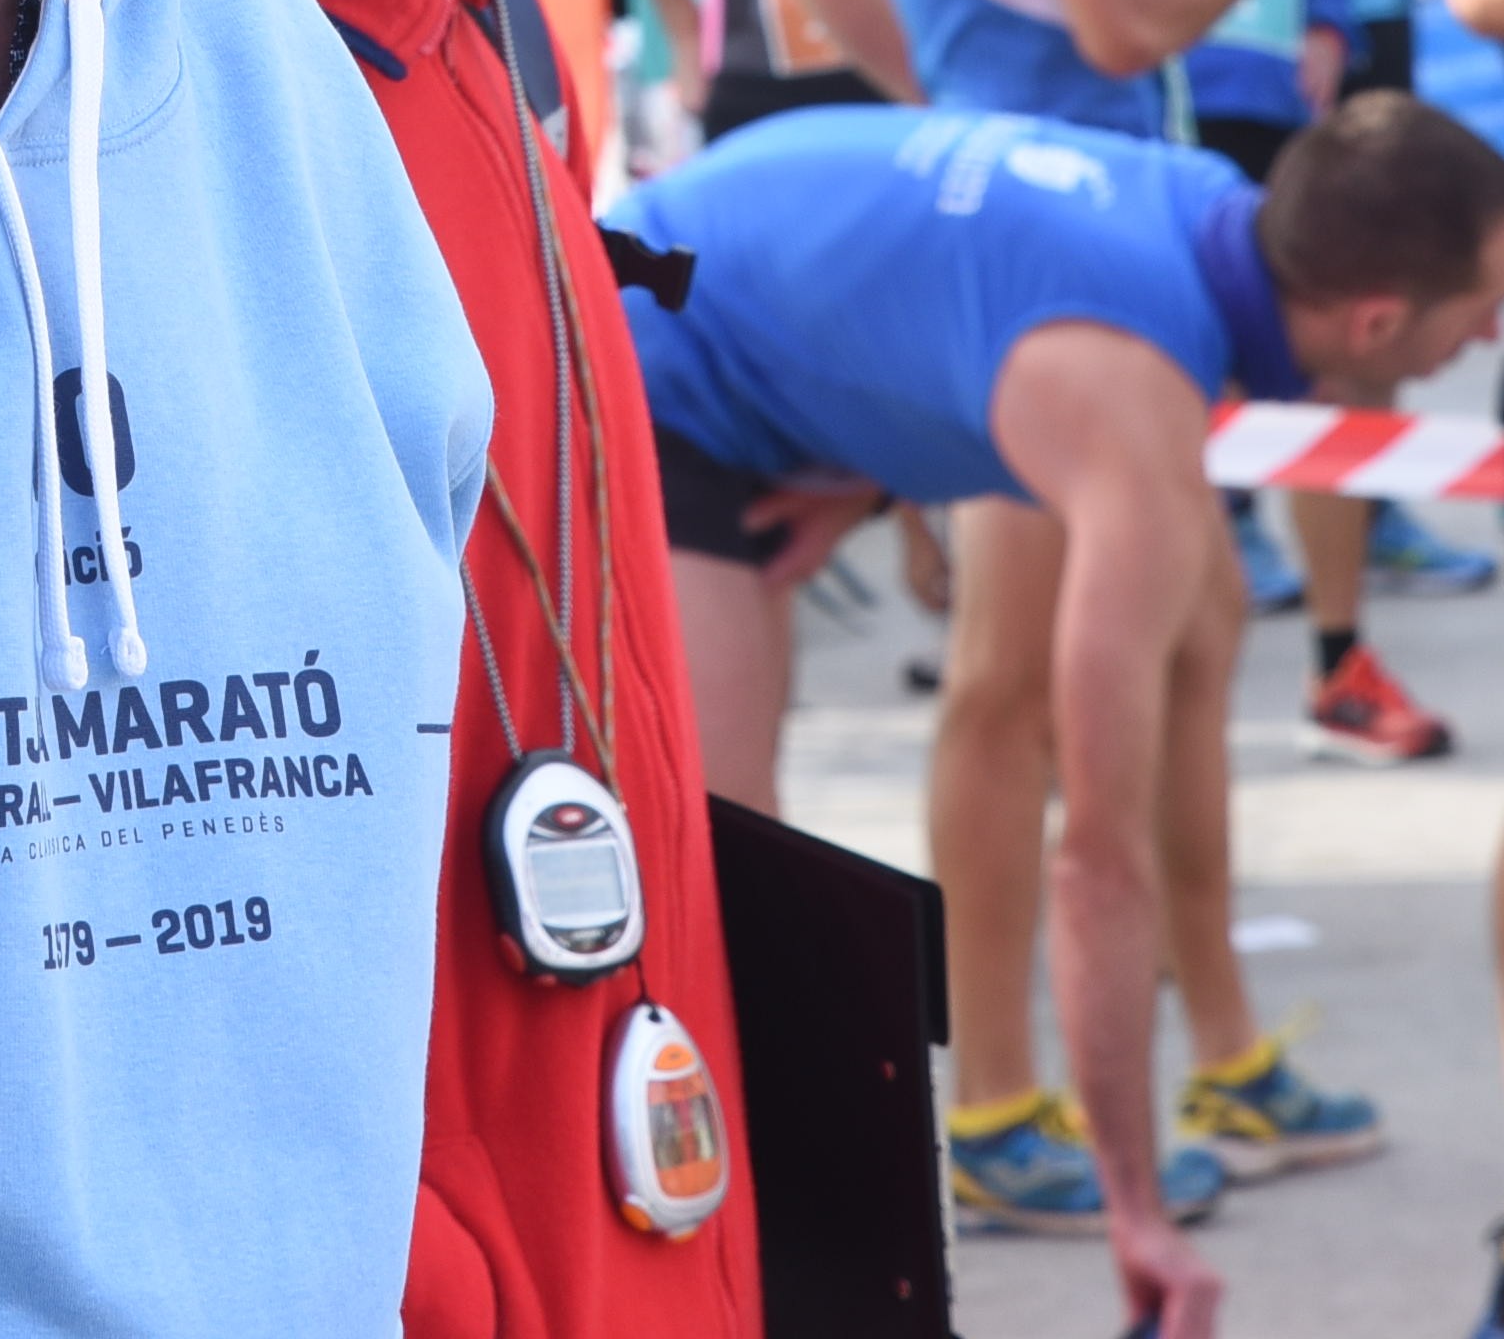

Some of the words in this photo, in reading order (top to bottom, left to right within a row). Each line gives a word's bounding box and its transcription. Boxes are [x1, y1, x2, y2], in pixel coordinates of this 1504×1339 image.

[50, 649, 342, 761] MARATÓ
[87, 752, 375, 814] VILAFRANCA
[100, 826, 144, 849] DEL
[161, 810, 285, 841] PENEDÈS
[151, 895, 273, 956] 2019
